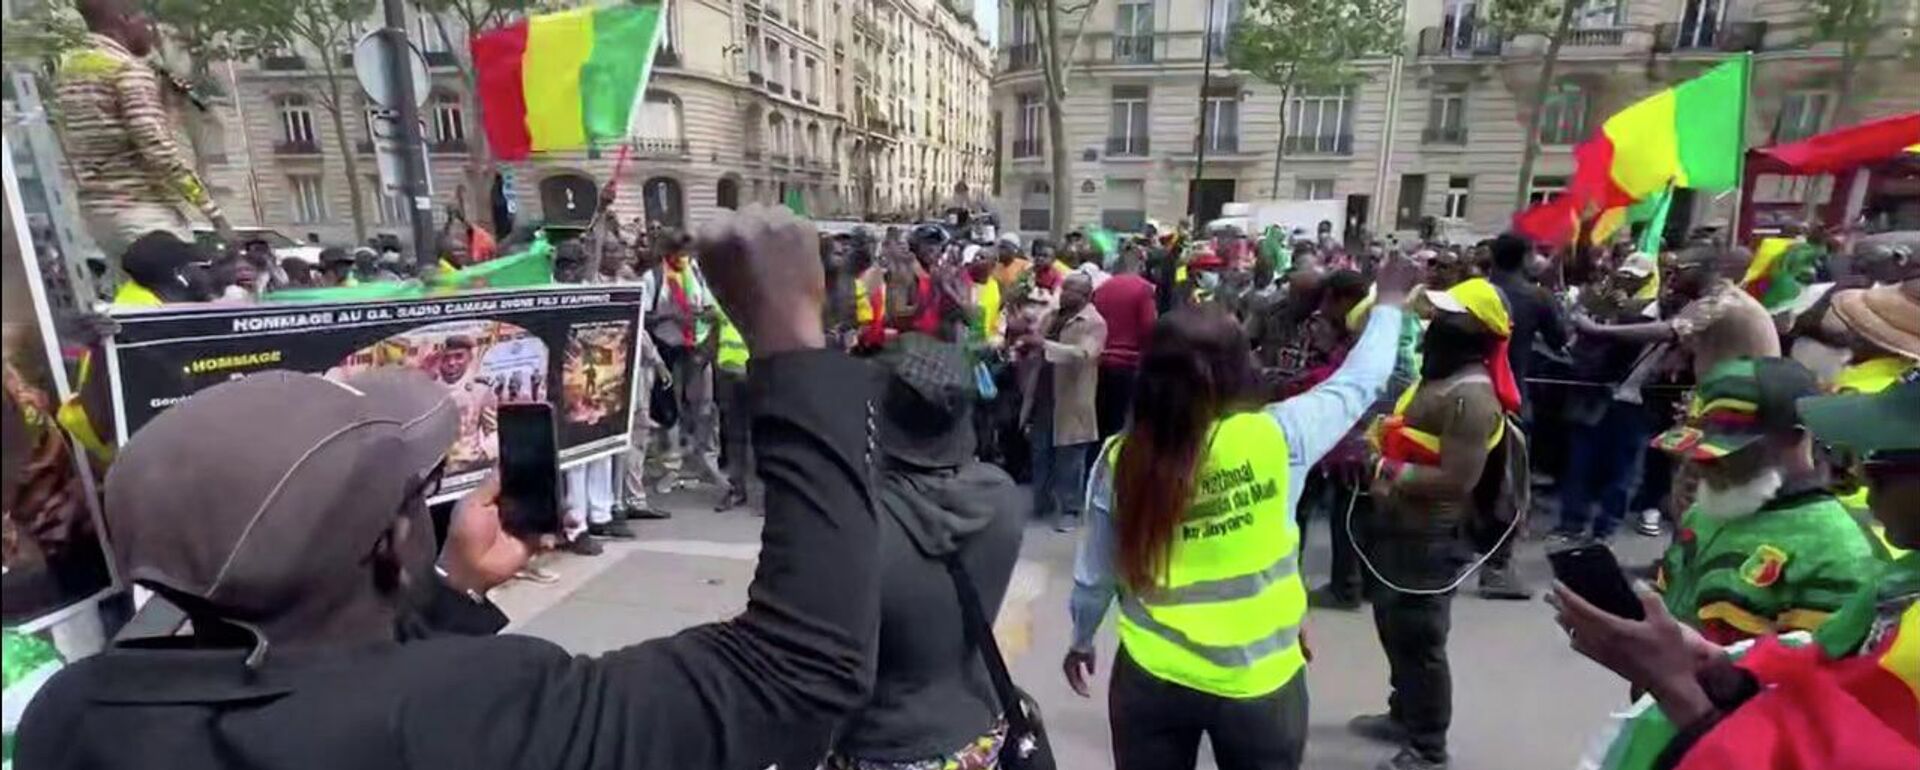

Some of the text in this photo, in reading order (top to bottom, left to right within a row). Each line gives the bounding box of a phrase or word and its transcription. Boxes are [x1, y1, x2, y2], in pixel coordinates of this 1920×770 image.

[233, 312, 333, 332] HOMMAGE
[337, 310, 362, 323] AU
[397, 303, 440, 318] SADIO
[192, 351, 282, 373] HOMMAGE
